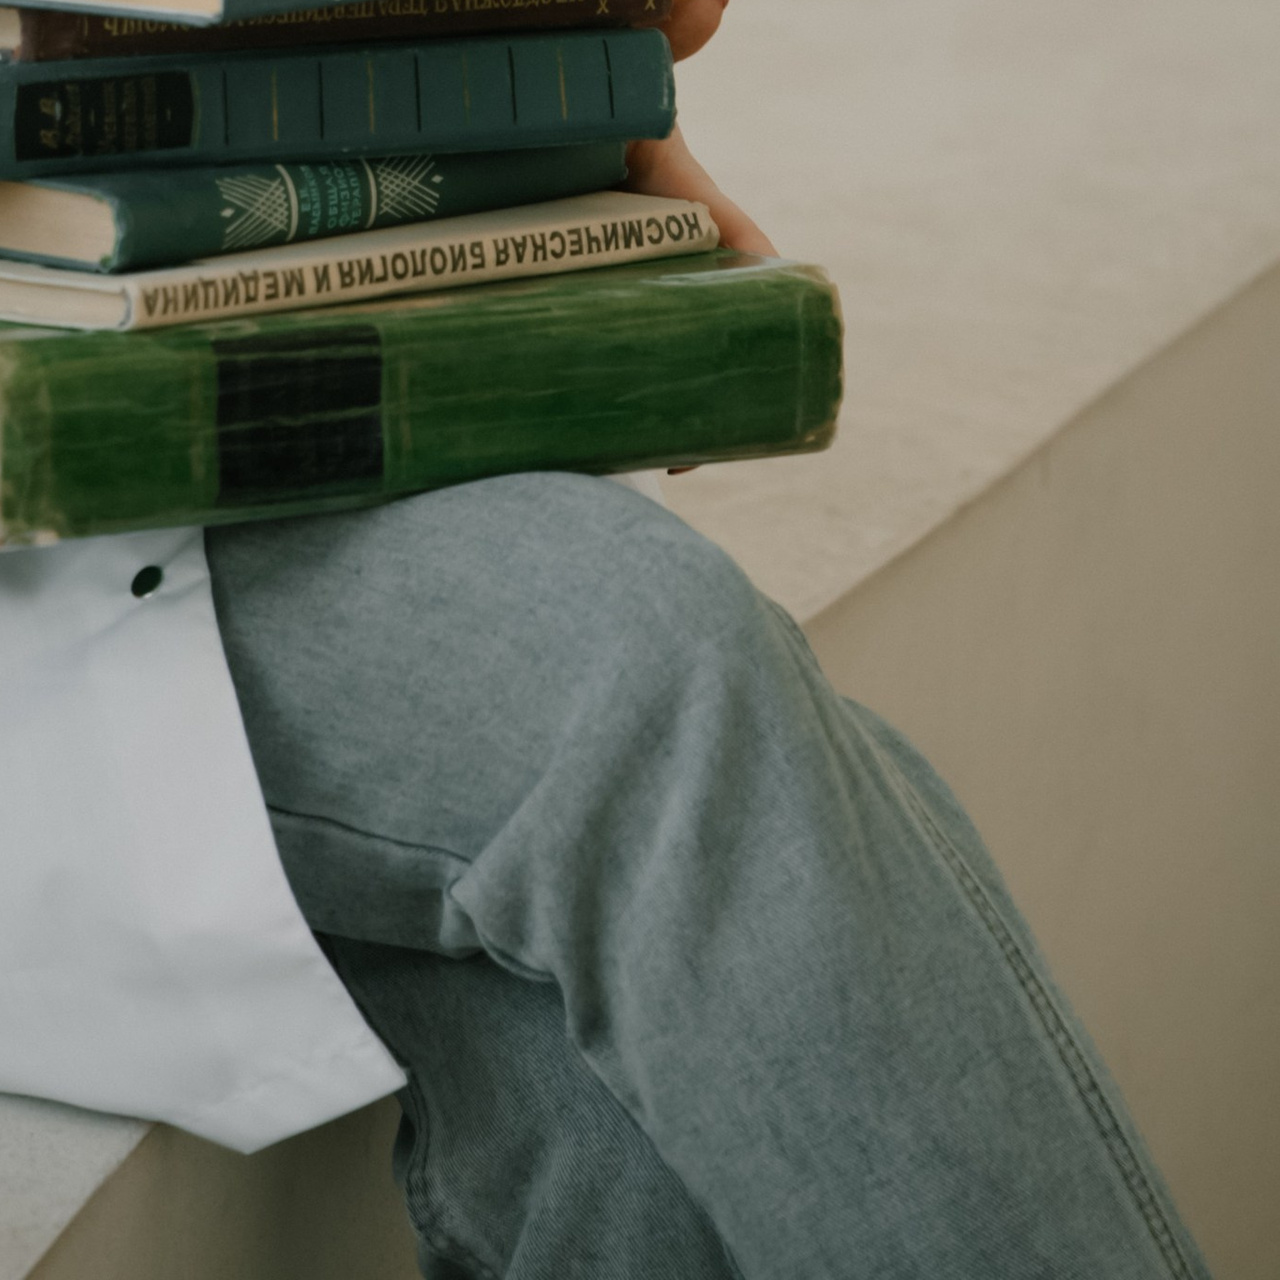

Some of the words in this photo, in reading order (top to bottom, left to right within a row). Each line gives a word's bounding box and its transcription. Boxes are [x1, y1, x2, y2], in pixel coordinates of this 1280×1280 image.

[346, 167, 362, 227] ТЕРАПИ
[494, 212, 703, 265] КОСМИЧЕСКАЯ
[143, 268, 307, 318] МЕДИЦИНА
[314, 264, 331, 294] И
[339, 252, 487, 290] БИОЛОГИЯ
